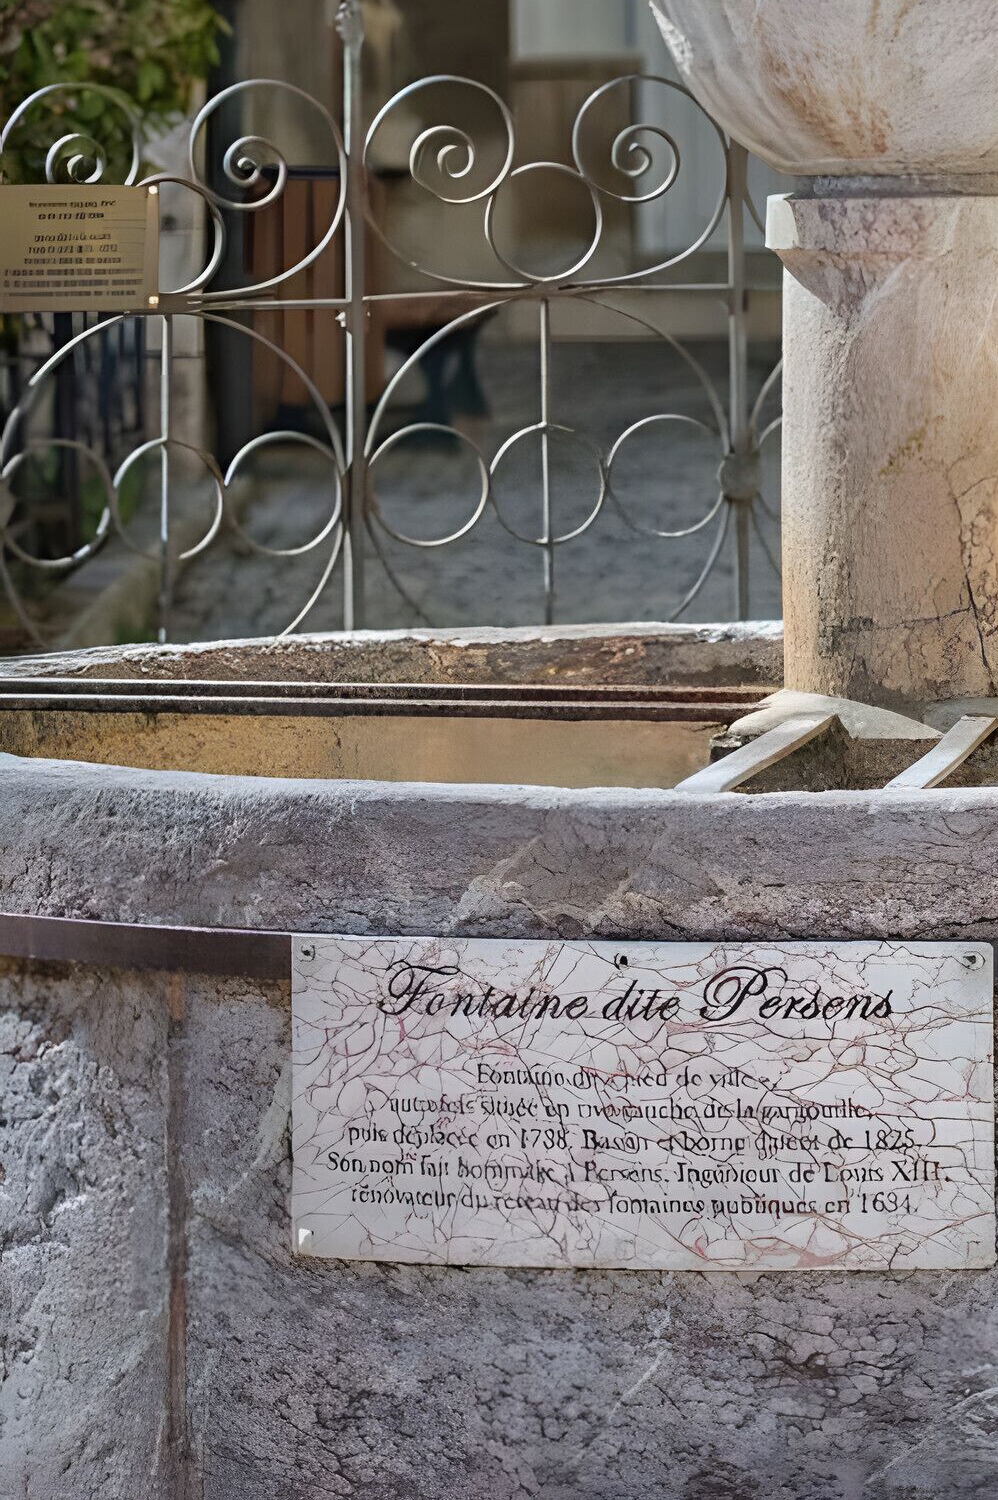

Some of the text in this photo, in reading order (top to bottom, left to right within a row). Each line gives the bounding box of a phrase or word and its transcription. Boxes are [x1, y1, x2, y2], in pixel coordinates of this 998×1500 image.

[377, 963, 894, 1020] Fontaine dite Persens
